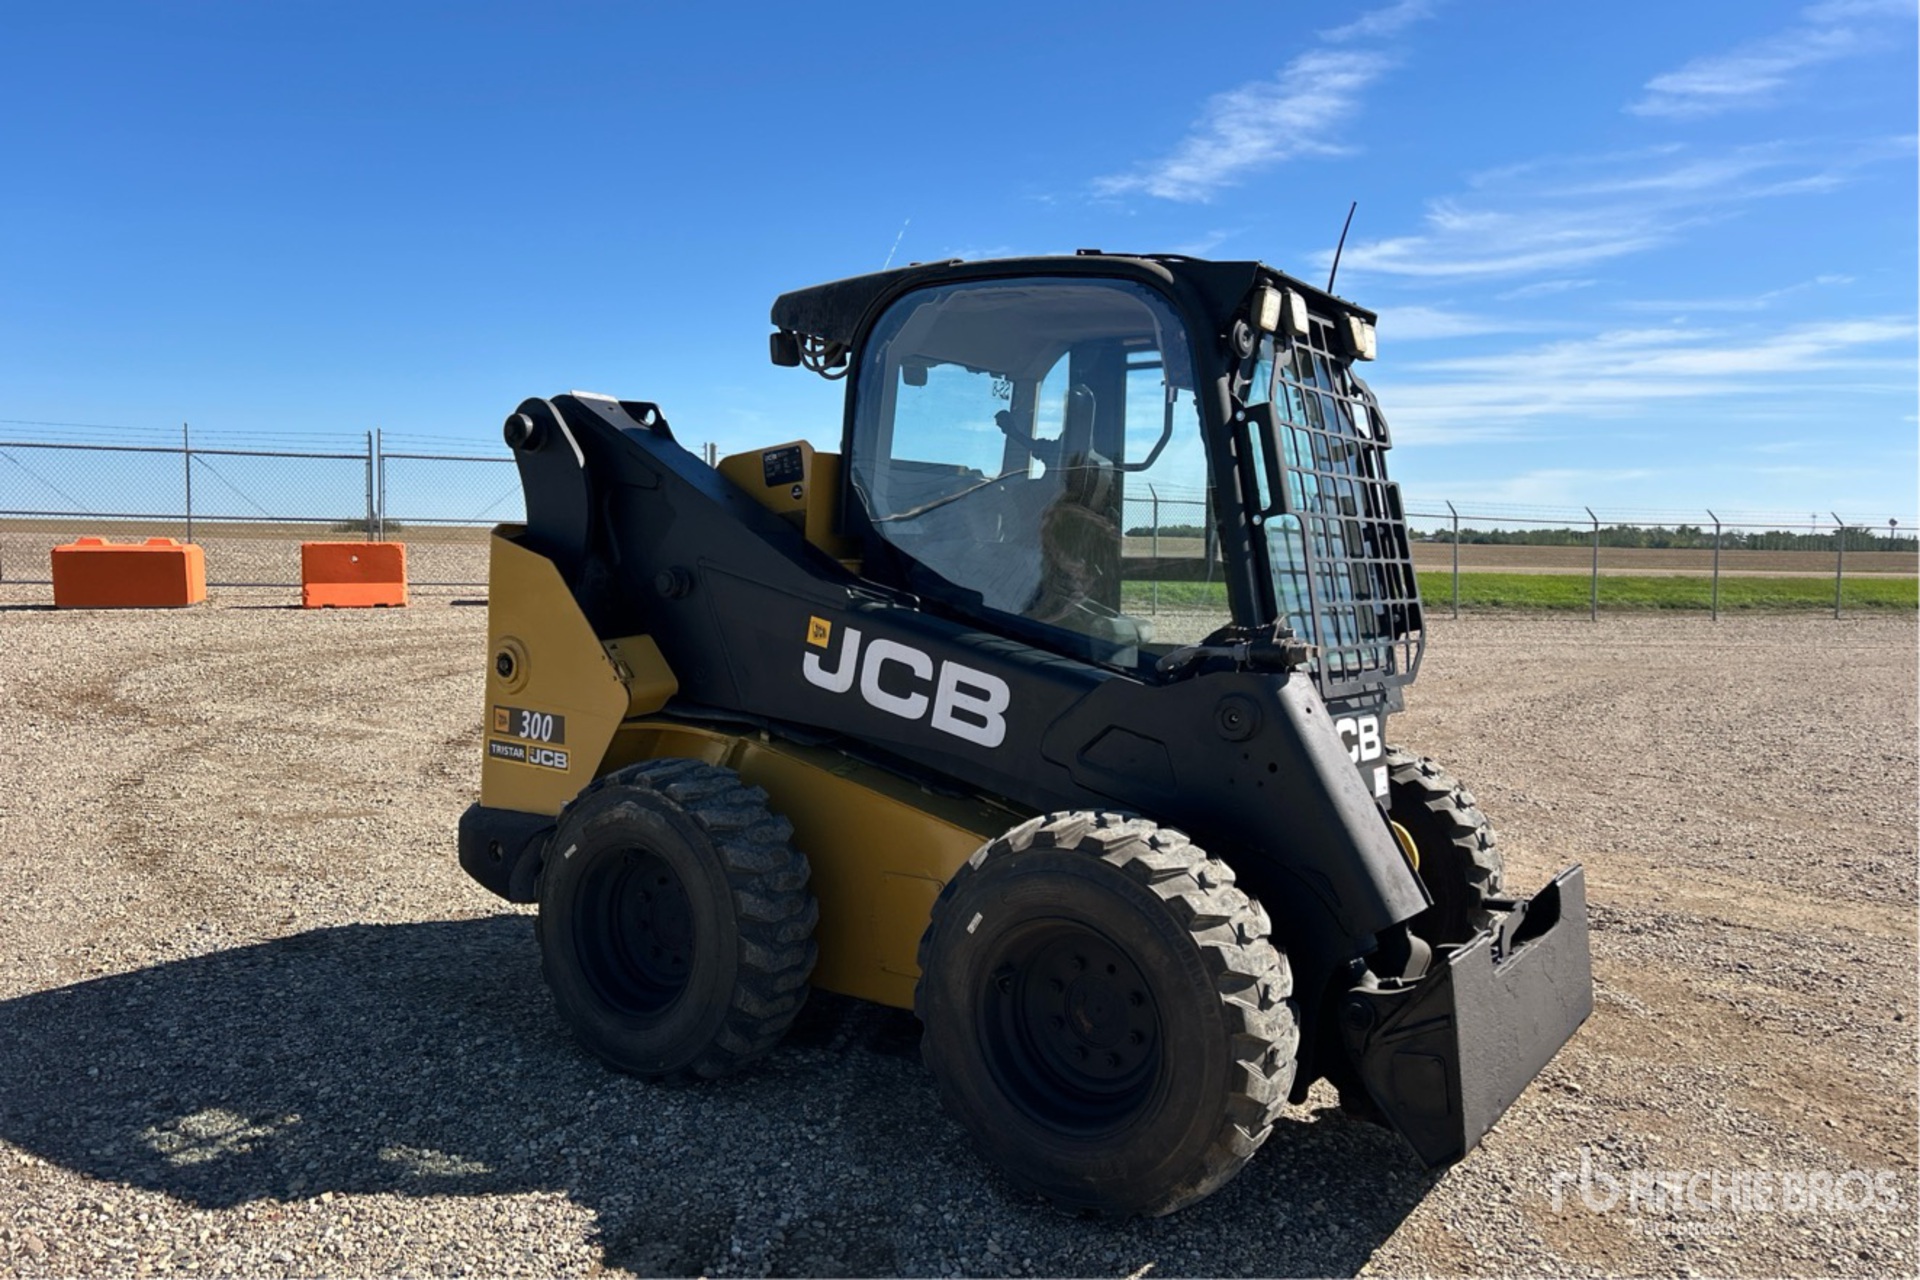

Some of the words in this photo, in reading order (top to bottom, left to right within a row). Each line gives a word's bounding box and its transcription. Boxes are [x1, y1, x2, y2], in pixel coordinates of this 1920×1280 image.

[802, 626, 1011, 748] JCB
[519, 710, 553, 742] 300
[1336, 713, 1382, 764] CB
[491, 744, 524, 758] TRISTAR
[529, 750, 567, 768] JCB
